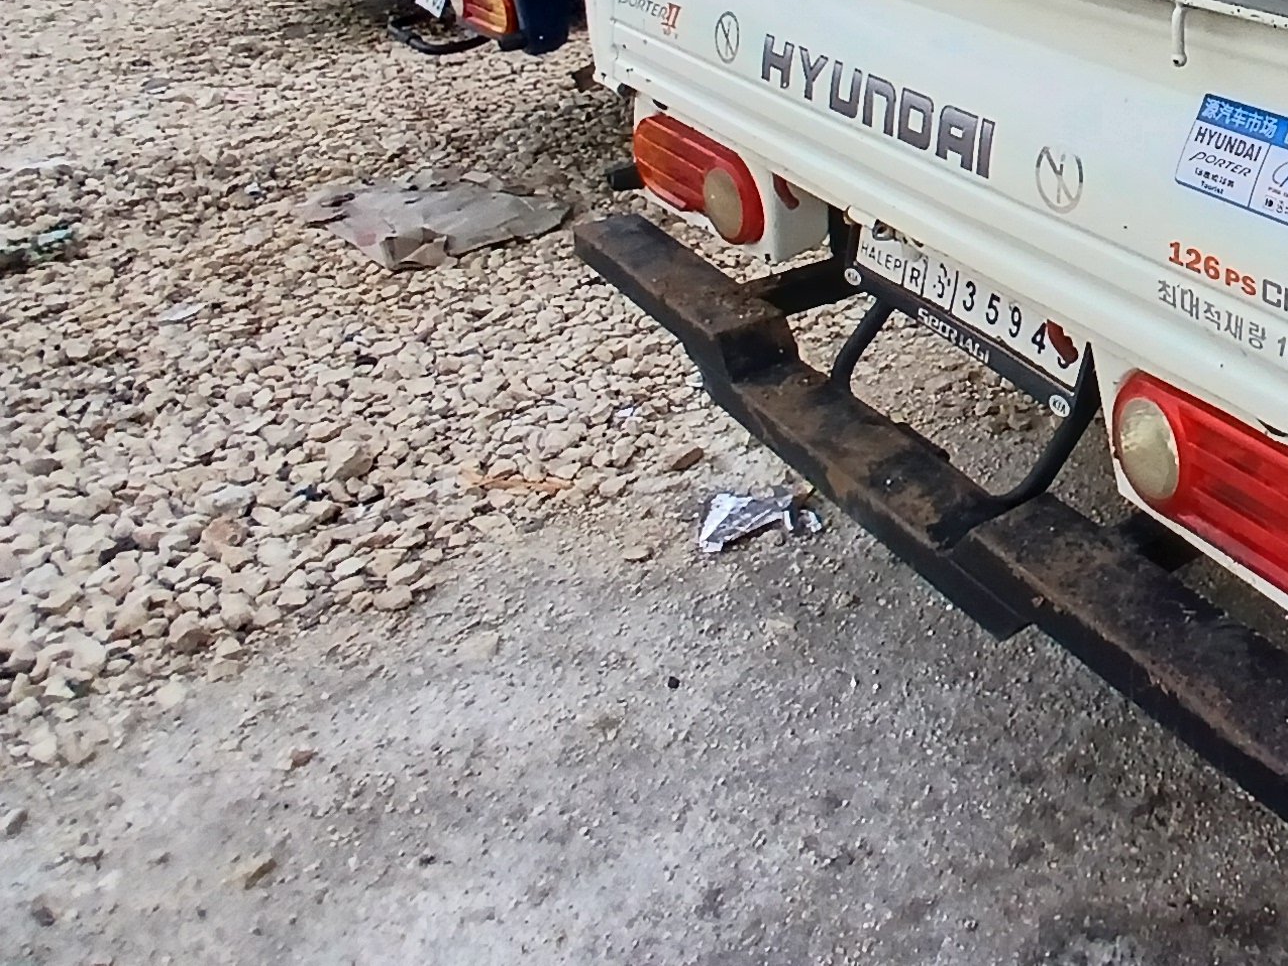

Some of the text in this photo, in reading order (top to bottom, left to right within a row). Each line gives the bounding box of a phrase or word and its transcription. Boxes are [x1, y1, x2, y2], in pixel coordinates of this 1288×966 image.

[760, 32, 996, 180] HYUNDAI
[1194, 125, 1264, 163] HYUNDAI
[1188, 150, 1252, 178] PORTER
[860, 240, 903, 271] HALEP
[909, 266, 922, 288] R
[1052, 398, 1067, 415] KIA
